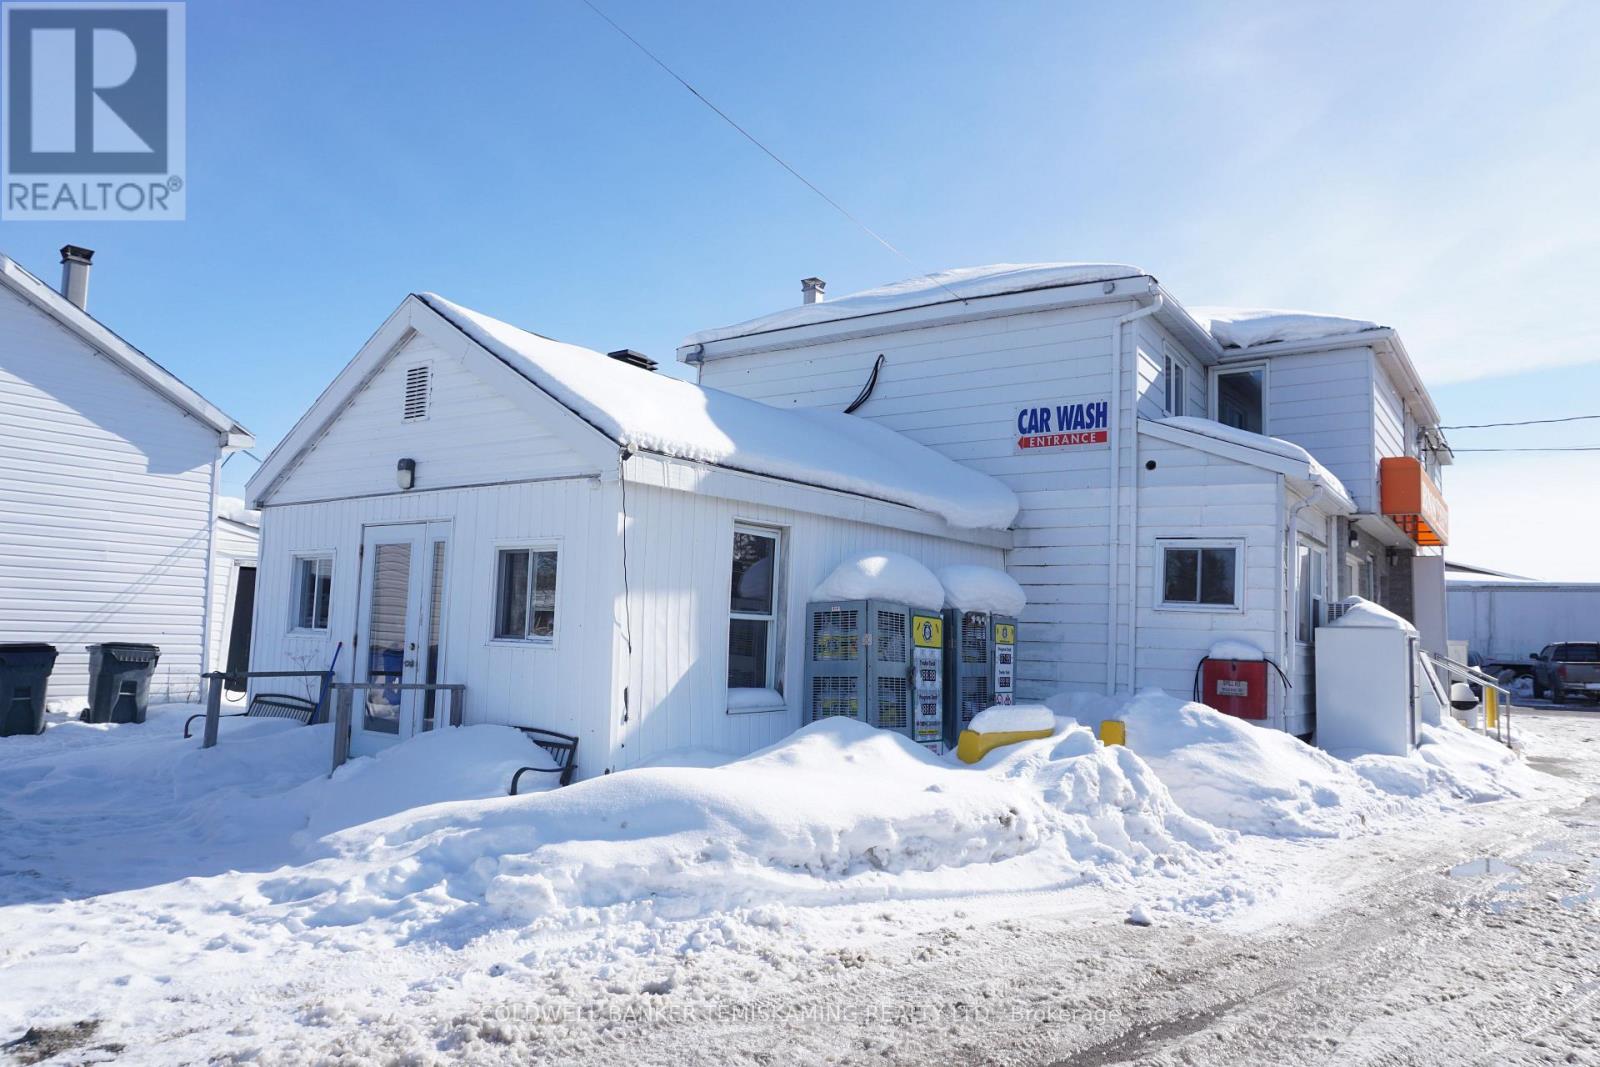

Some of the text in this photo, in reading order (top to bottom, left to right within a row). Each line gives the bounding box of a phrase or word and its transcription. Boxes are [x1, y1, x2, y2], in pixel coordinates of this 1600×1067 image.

[1018, 401, 1108, 434] CAR WASH
[1029, 432, 1097, 447] ENTRANCE
